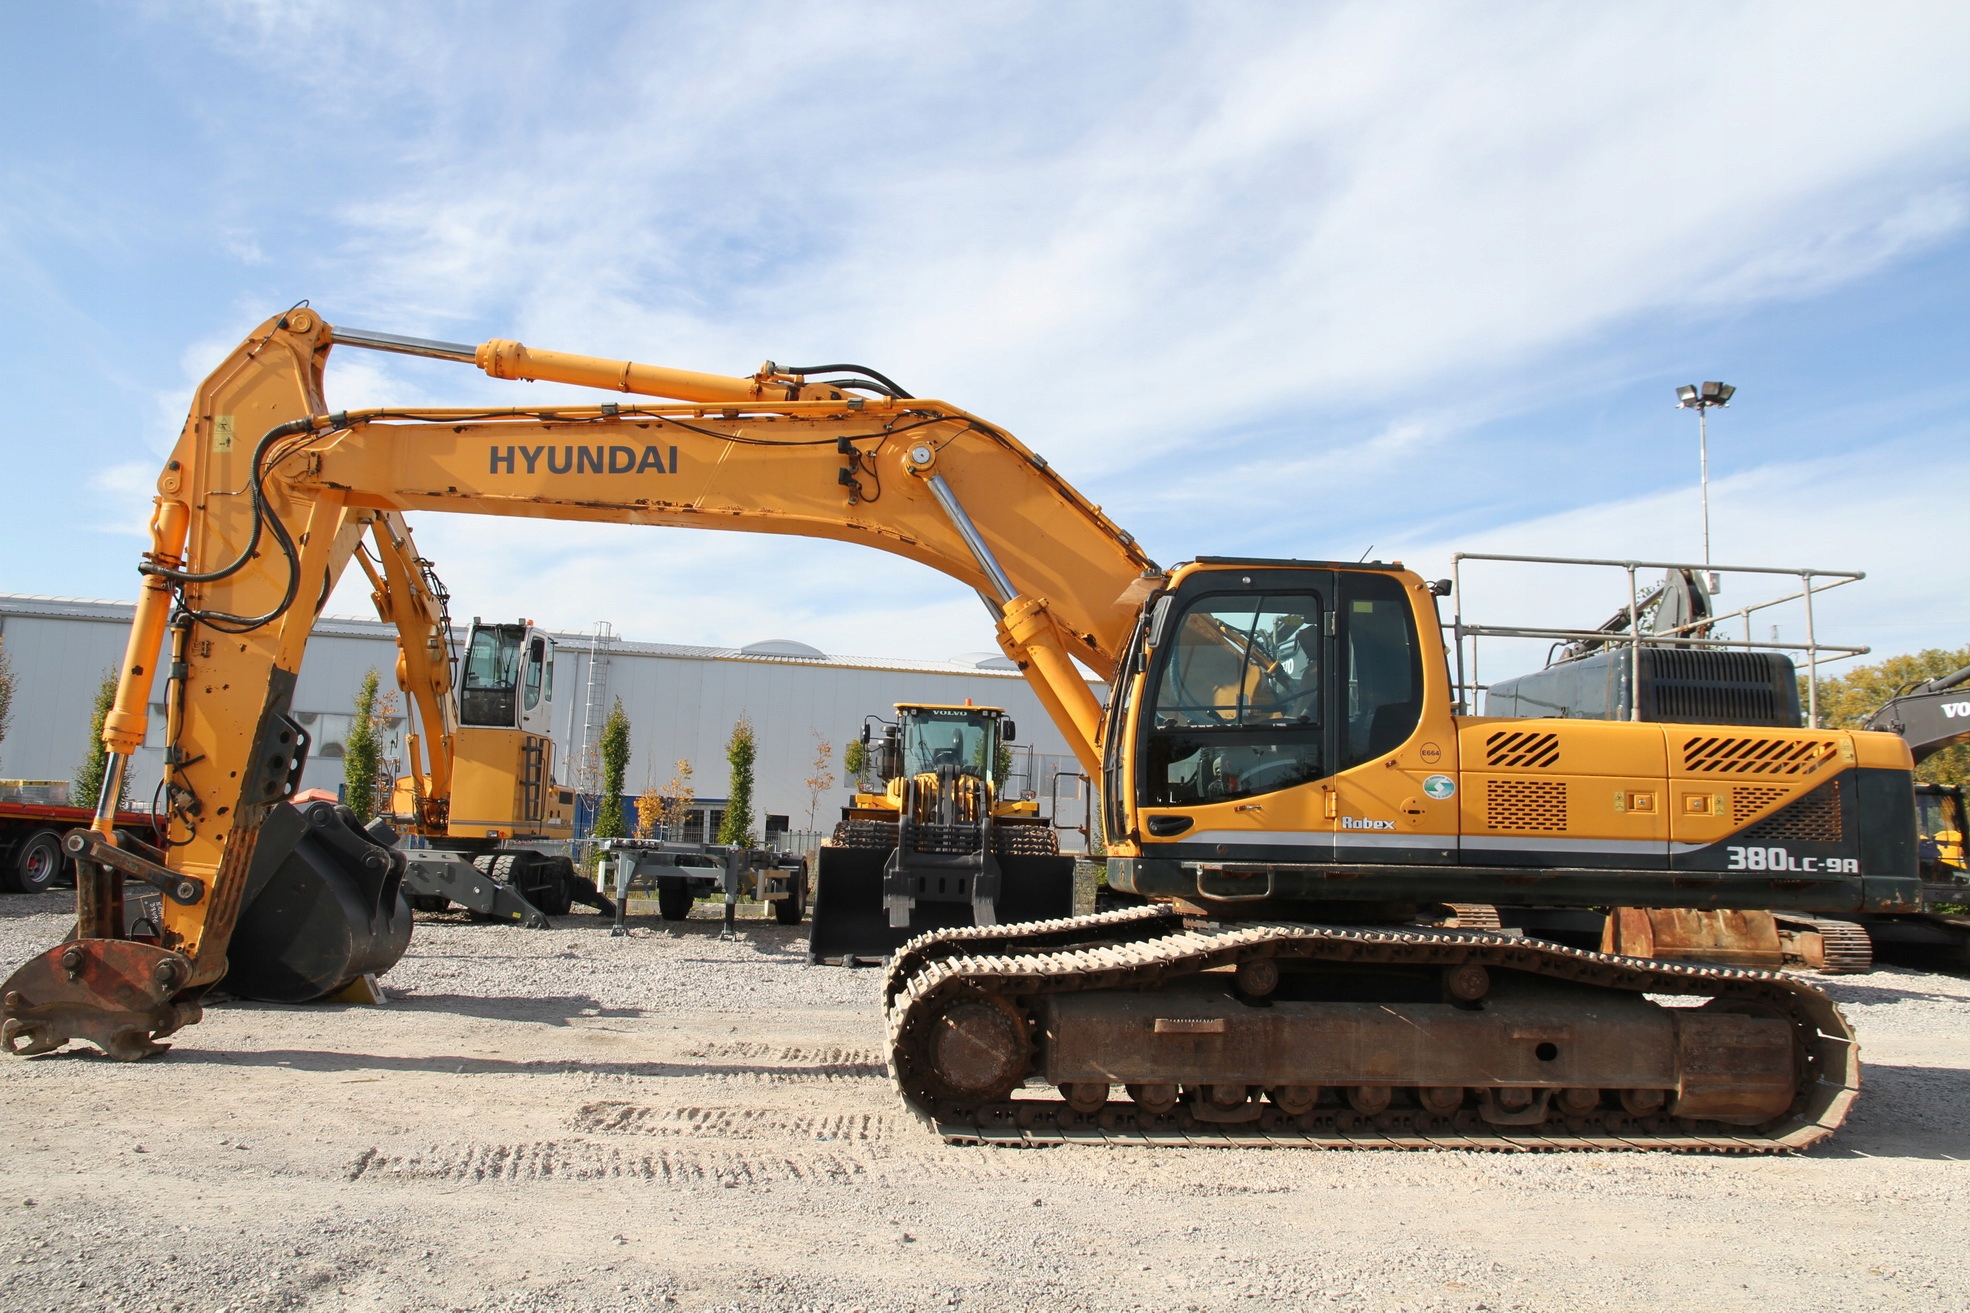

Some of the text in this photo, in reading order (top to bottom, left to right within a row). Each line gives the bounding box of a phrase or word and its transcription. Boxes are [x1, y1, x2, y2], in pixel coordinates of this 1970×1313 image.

[489, 445, 678, 474] HYUNDAI
[1342, 816, 1396, 830] Robex
[1726, 846, 1859, 873] 380LC-9A
